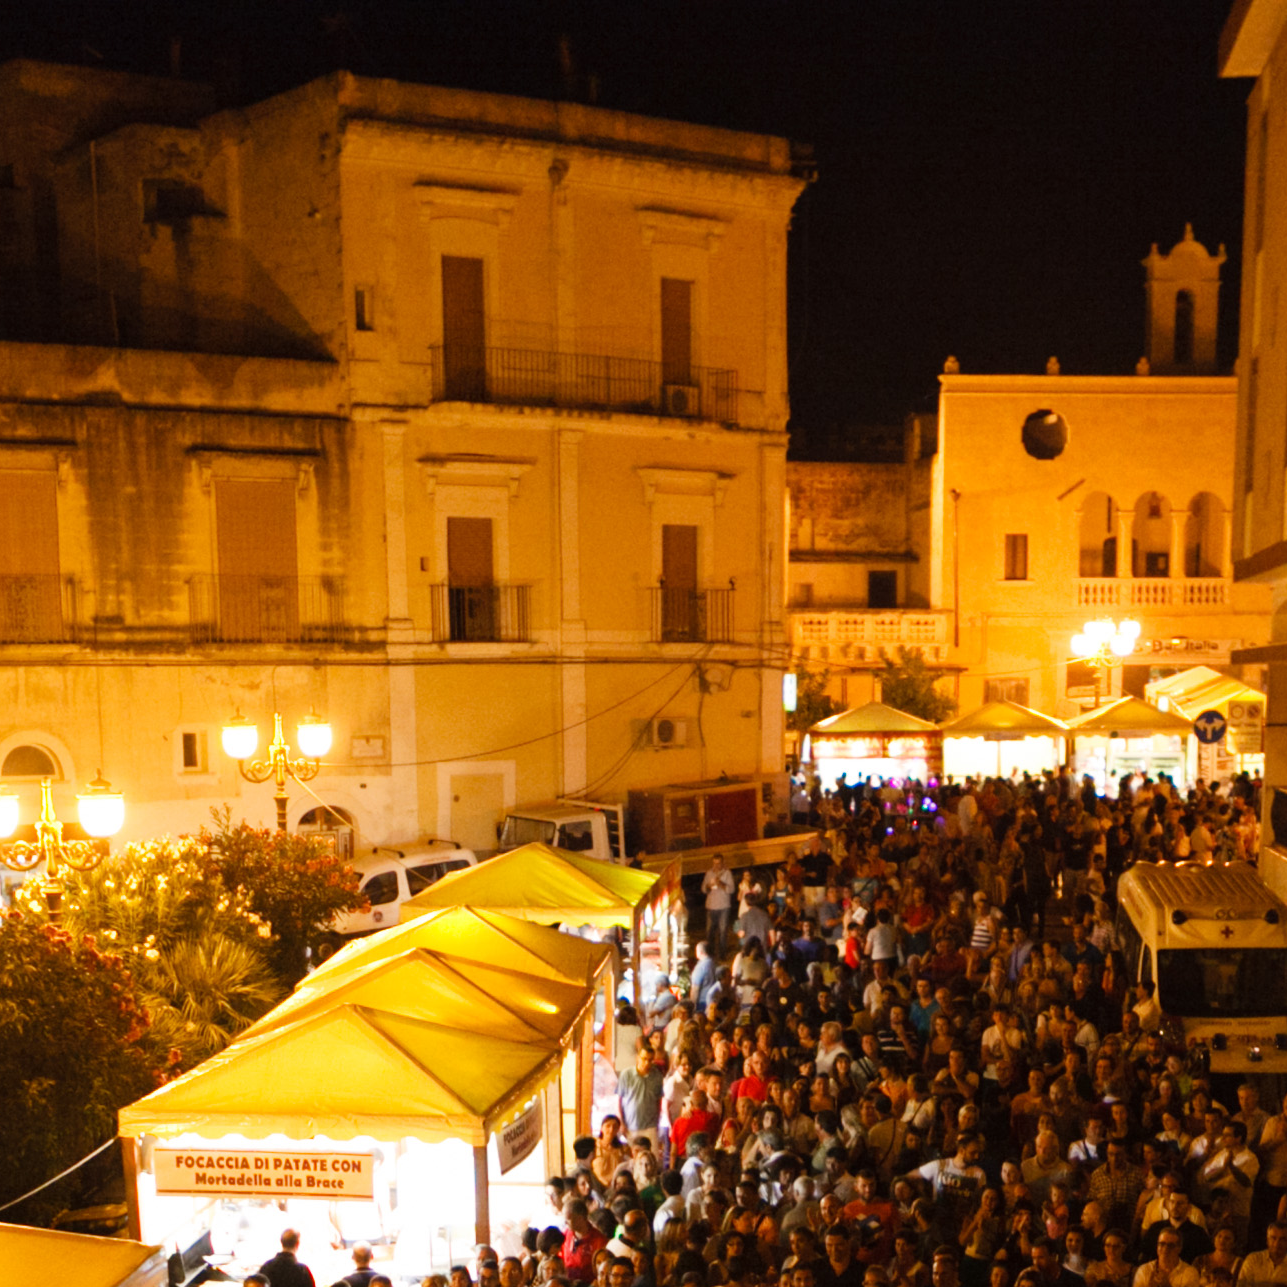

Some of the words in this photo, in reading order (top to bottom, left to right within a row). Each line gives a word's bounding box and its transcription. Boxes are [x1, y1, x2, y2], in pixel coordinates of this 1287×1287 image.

[175, 1156, 250, 1170] FOCACCIA
[254, 1157, 270, 1170] DI
[273, 1158, 328, 1172] PATATE
[331, 1160, 362, 1173] CON
[195, 1173, 271, 1187] Mortadella
[275, 1174, 302, 1187] alla
[306, 1176, 344, 1189] Brace
